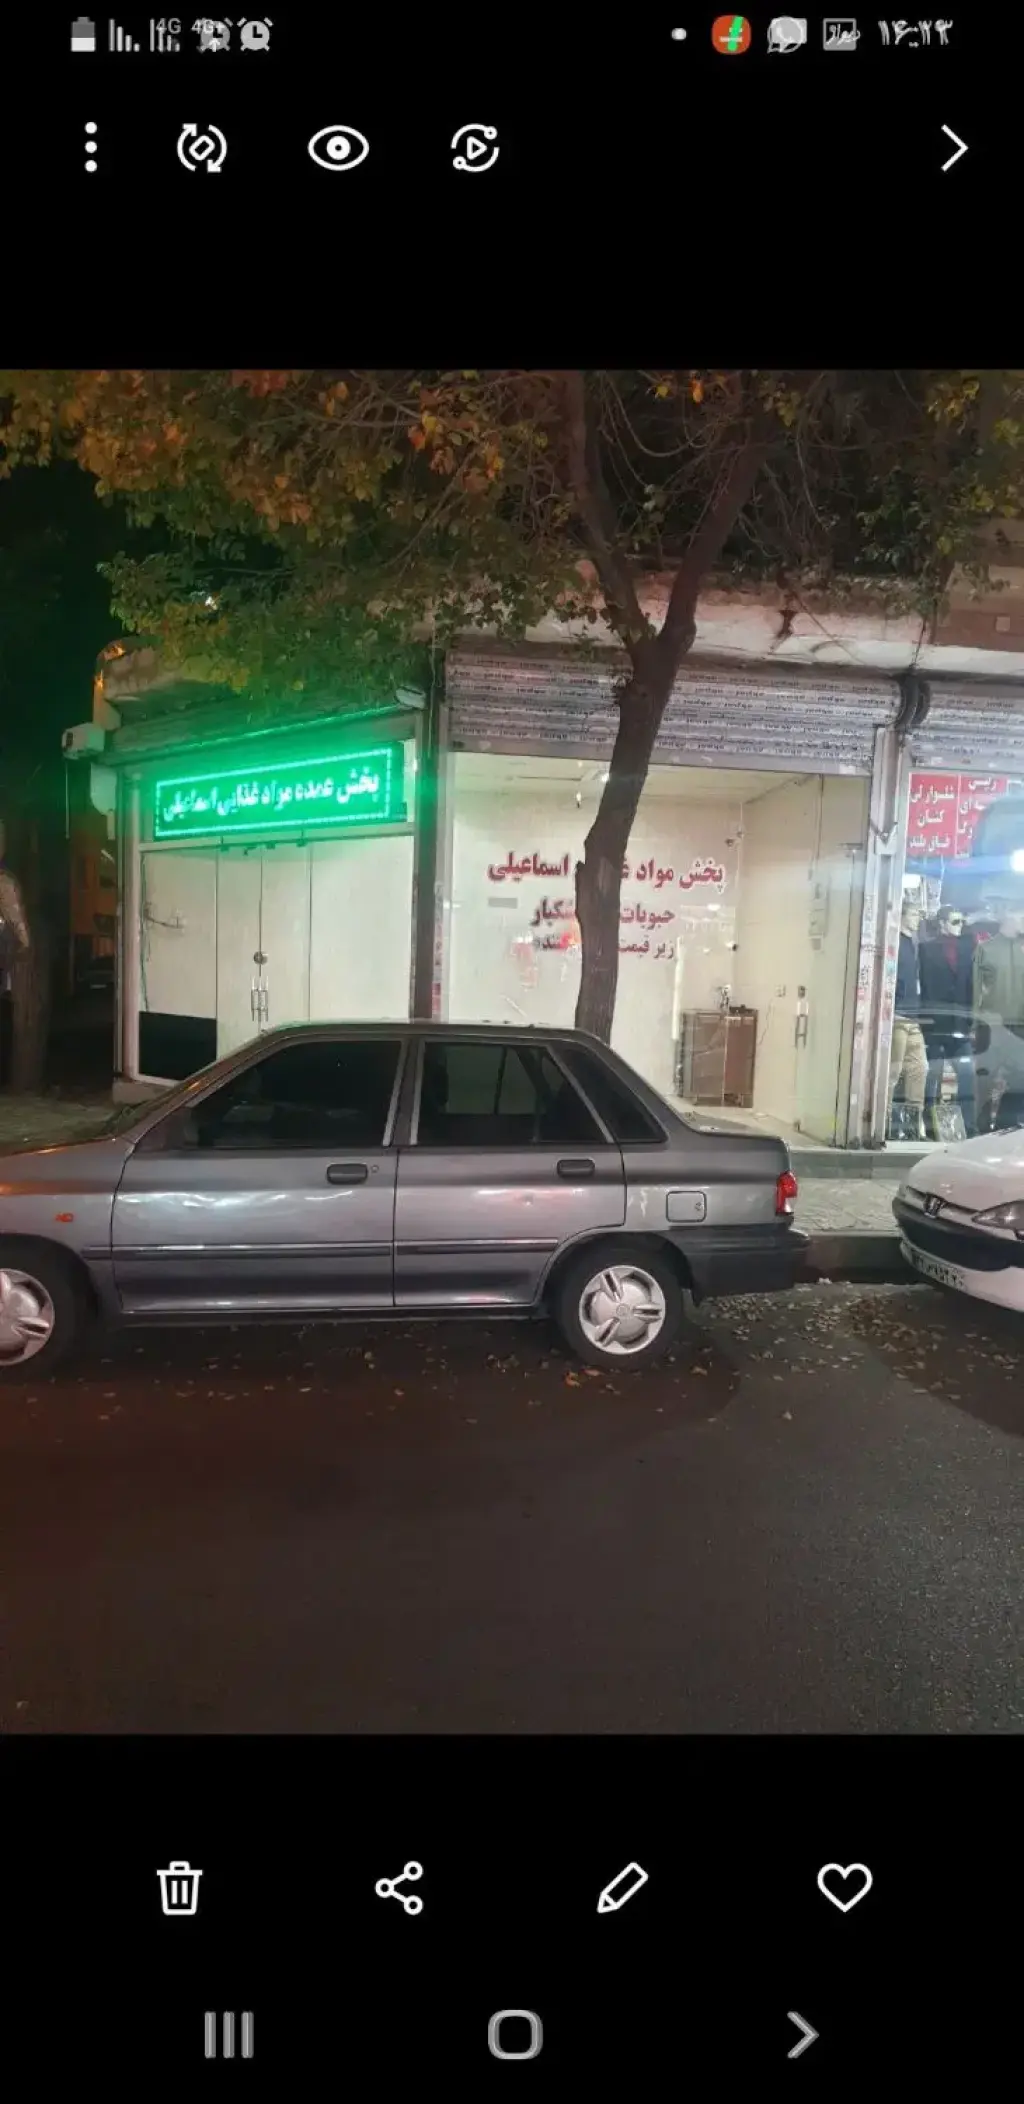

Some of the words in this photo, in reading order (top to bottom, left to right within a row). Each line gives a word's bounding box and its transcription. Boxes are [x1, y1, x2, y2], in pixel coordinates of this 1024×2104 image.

[295, 777, 334, 802] عمده
[336, 766, 380, 803] پخش
[488, 852, 570, 884] اسماعیلی
[636, 859, 674, 889] مواد
[679, 859, 724, 893] پخش
[620, 902, 676, 930] حبوبات
[653, 940, 675, 960] زیر
